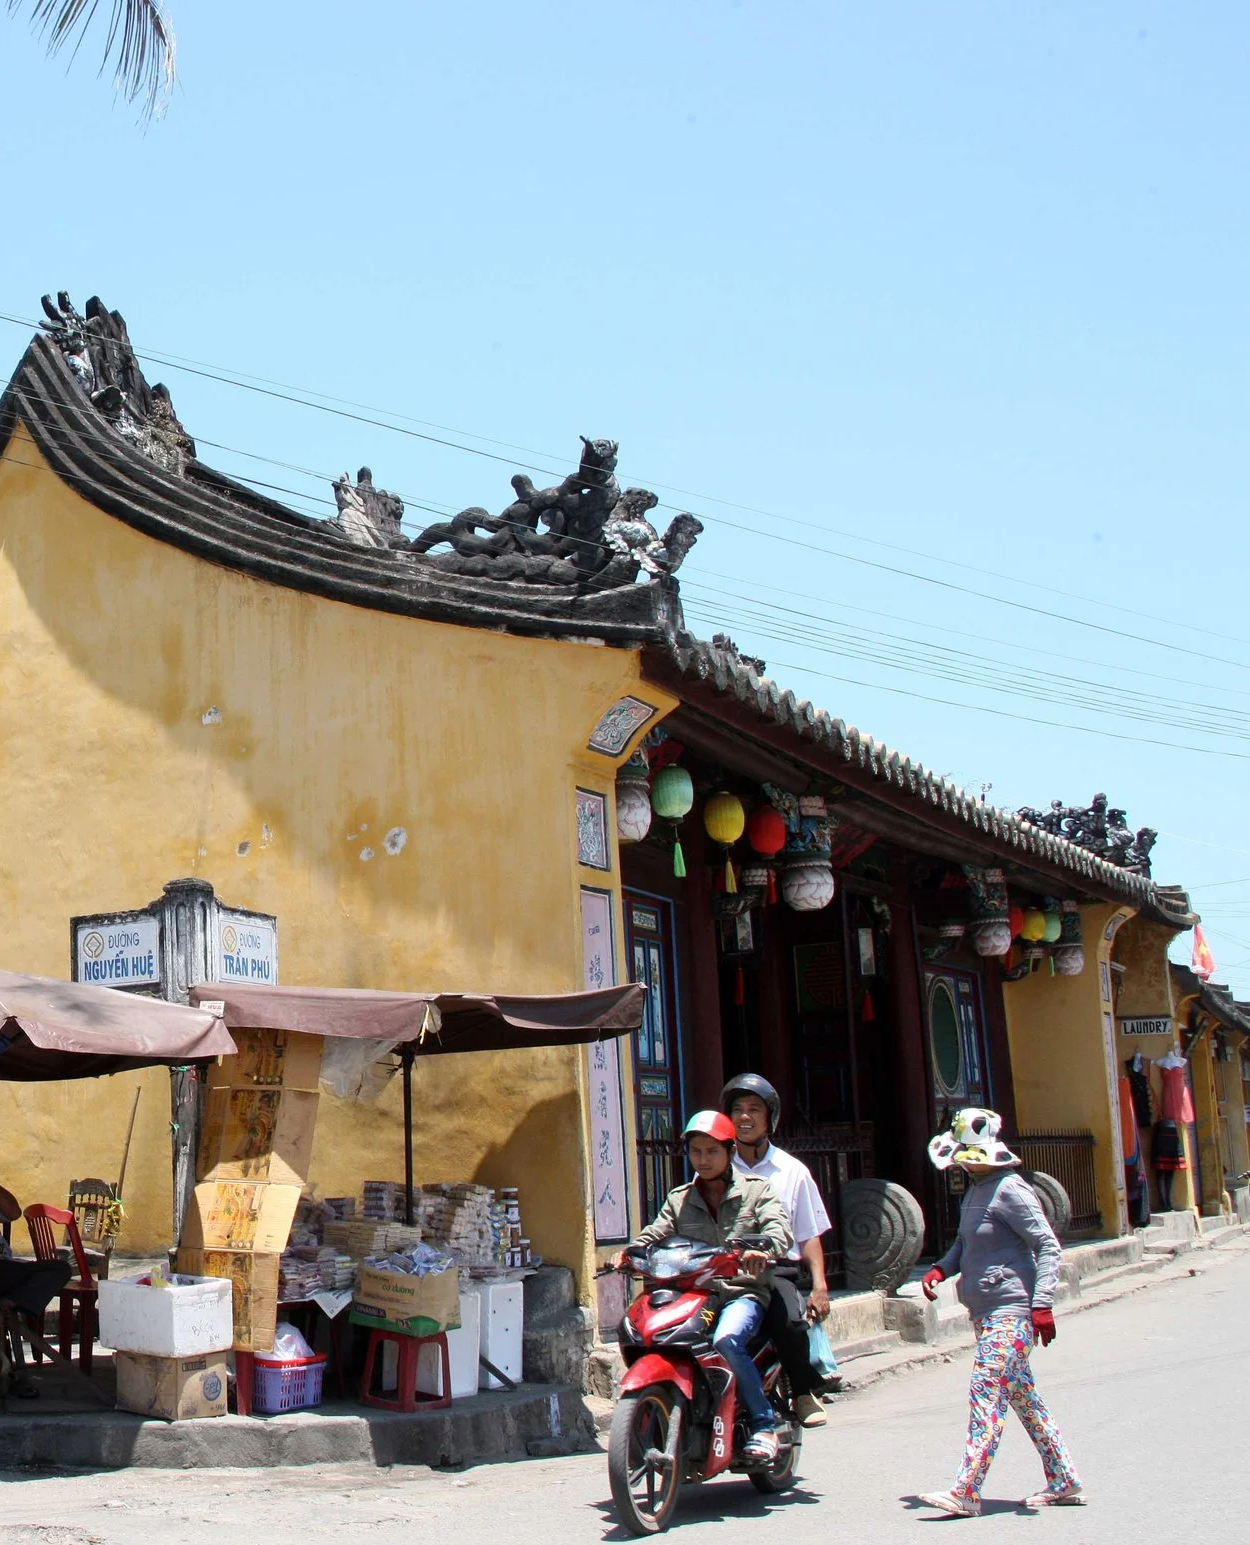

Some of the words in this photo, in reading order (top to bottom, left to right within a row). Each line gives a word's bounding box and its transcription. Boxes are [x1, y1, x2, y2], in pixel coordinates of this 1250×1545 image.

[108, 931, 140, 949] ĐƯỜNG
[84, 950, 129, 981] NGUYỄN
[132, 949, 154, 979] HUỆ
[223, 948, 249, 977] TRẦN
[251, 955, 270, 980] PHÚ
